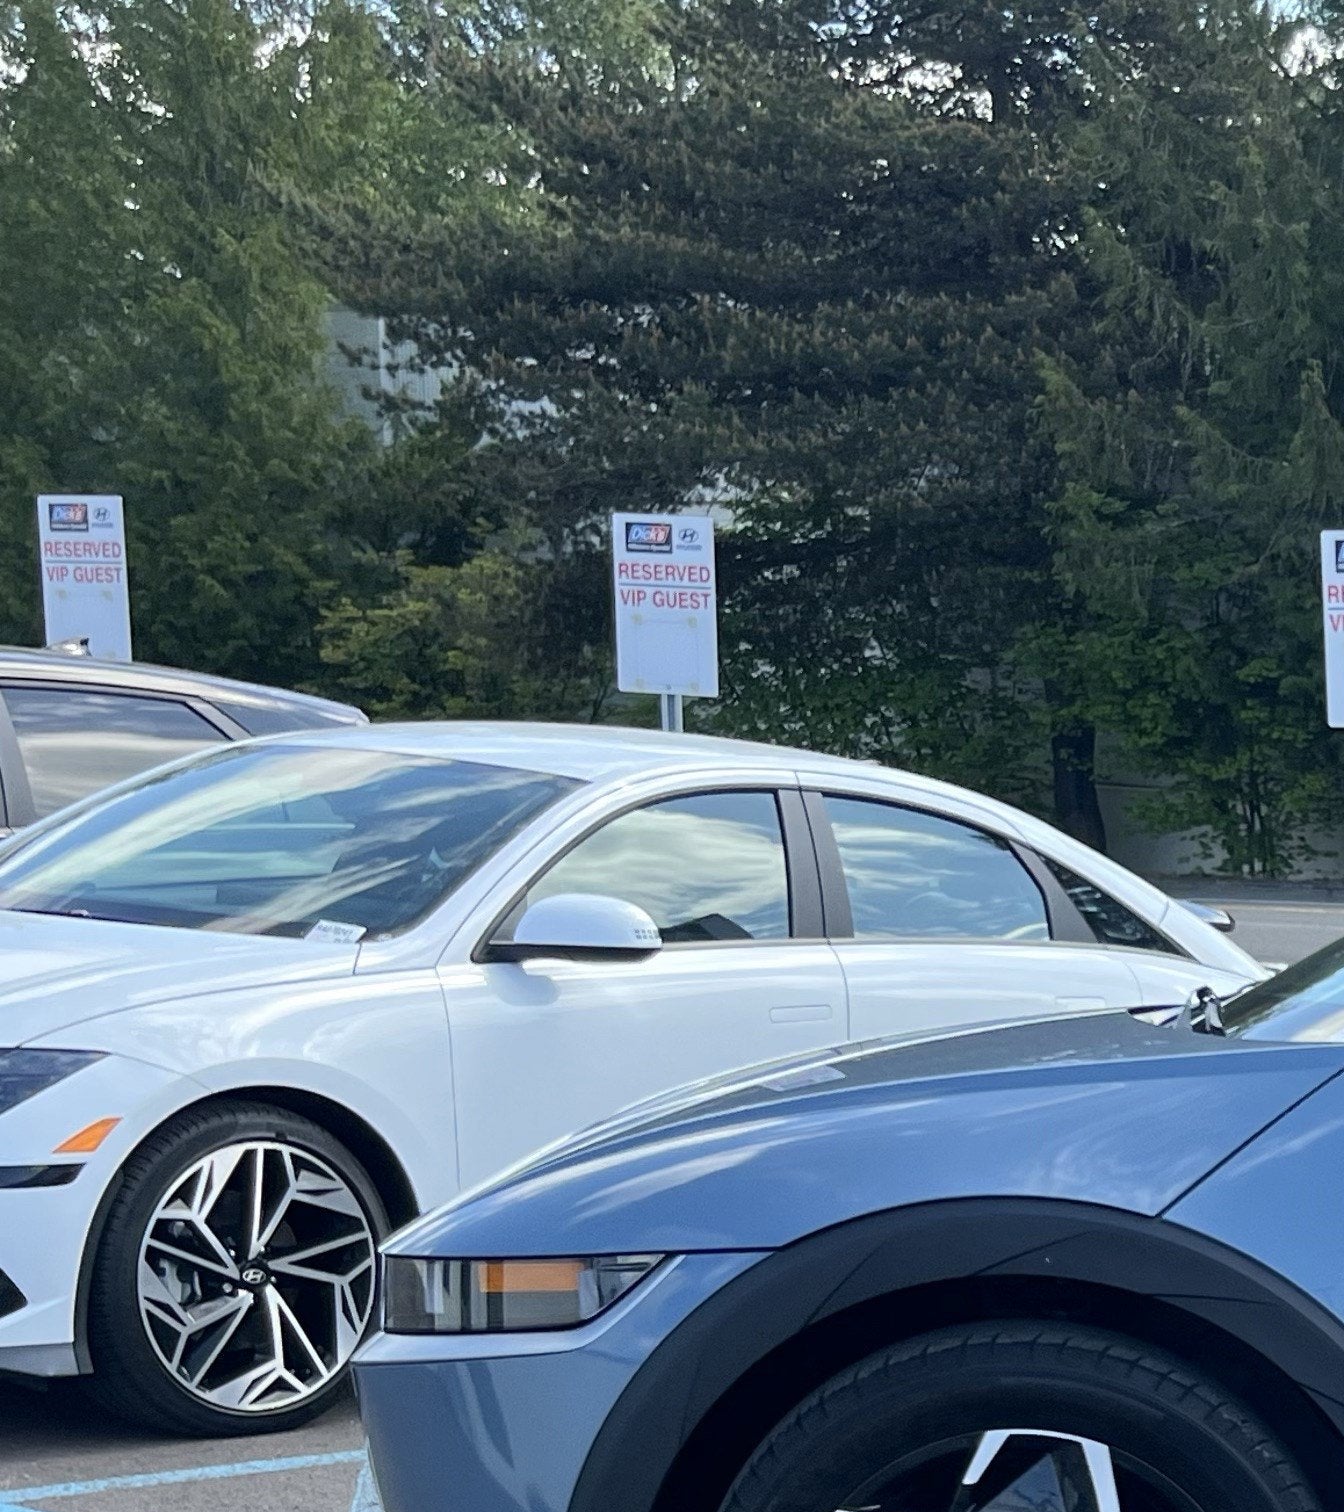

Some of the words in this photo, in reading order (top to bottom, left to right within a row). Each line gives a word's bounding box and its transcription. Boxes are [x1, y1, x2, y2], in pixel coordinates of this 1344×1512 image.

[43, 540, 122, 559] RESERVED
[45, 566, 69, 582] VIP
[73, 566, 123, 584] GUEST
[618, 562, 711, 583] RESERVED
[620, 589, 647, 607] VIP
[652, 590, 711, 610] GUEST
